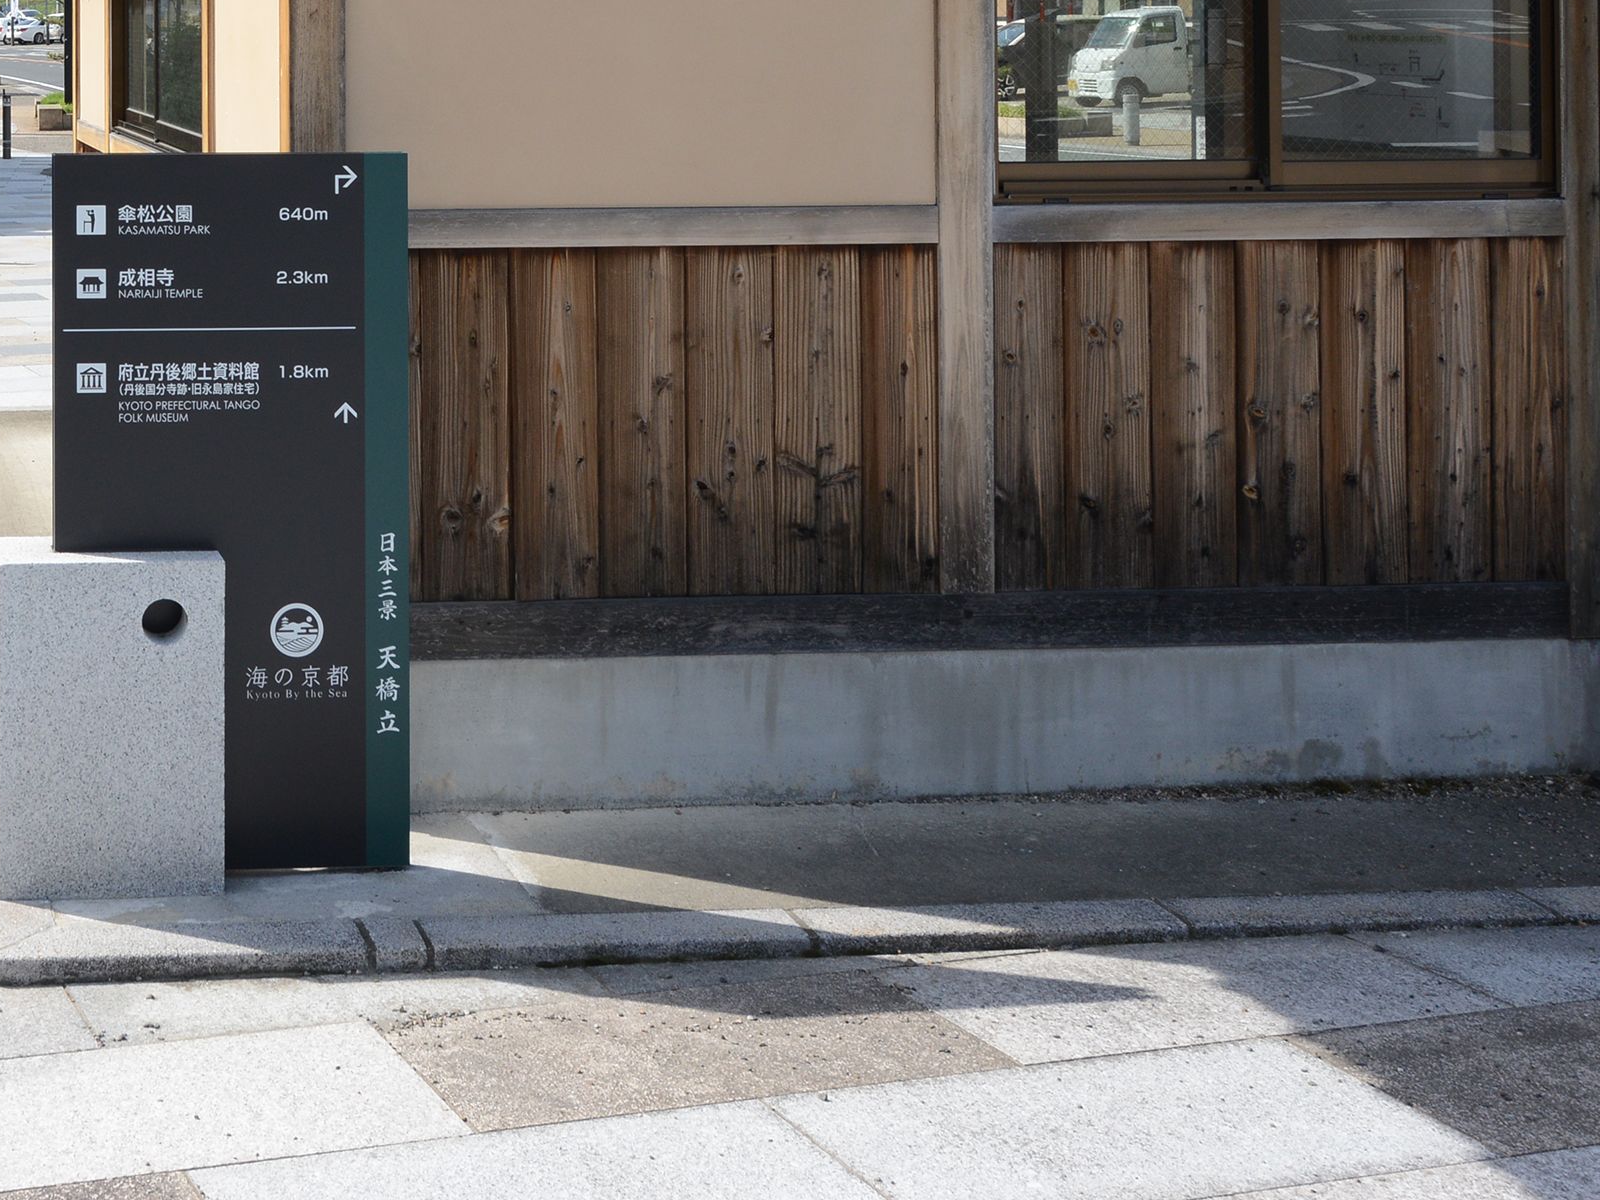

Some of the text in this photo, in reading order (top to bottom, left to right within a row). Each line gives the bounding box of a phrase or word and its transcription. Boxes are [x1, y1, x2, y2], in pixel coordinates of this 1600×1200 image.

[118, 205, 193, 223] 傘松公園
[279, 207, 328, 221] 640m
[118, 225, 211, 235] KASAMATSU PARK
[118, 268, 175, 287] 成相寺
[276, 270, 328, 284] 2.3km
[118, 289, 204, 299] NARIAIJI TEMPLE
[118, 362, 260, 381] 府立丹後郷土資料館
[279, 365, 329, 378] 1.8km
[118, 400, 261, 411] KYOTO PREFECTURAL TANGO
[118, 413, 189, 423] FOLK MUSEUM
[376, 532, 401, 734] 日本三景 天橋立
[245, 665, 349, 689] 海の京都
[246, 688, 348, 702] Kyoto By the Sea
